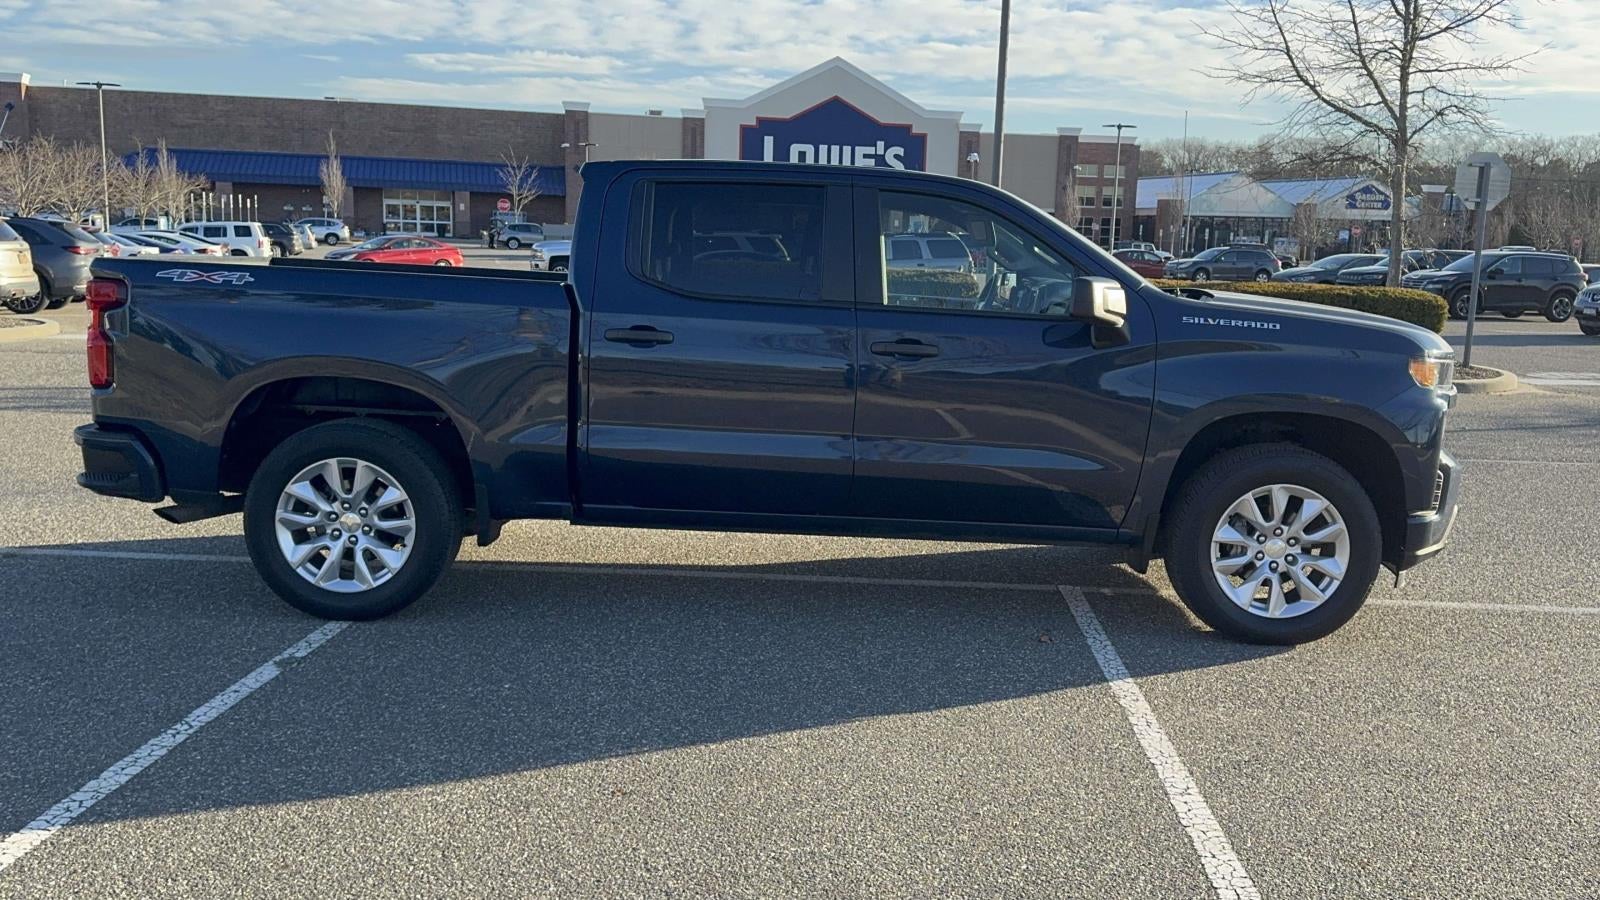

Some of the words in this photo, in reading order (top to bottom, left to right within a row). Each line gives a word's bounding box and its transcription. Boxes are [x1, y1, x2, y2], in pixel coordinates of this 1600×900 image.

[1355, 192, 1385, 201] GARDEN
[1355, 200, 1382, 209] CENTER
[1182, 316, 1281, 329] SILVERADO
